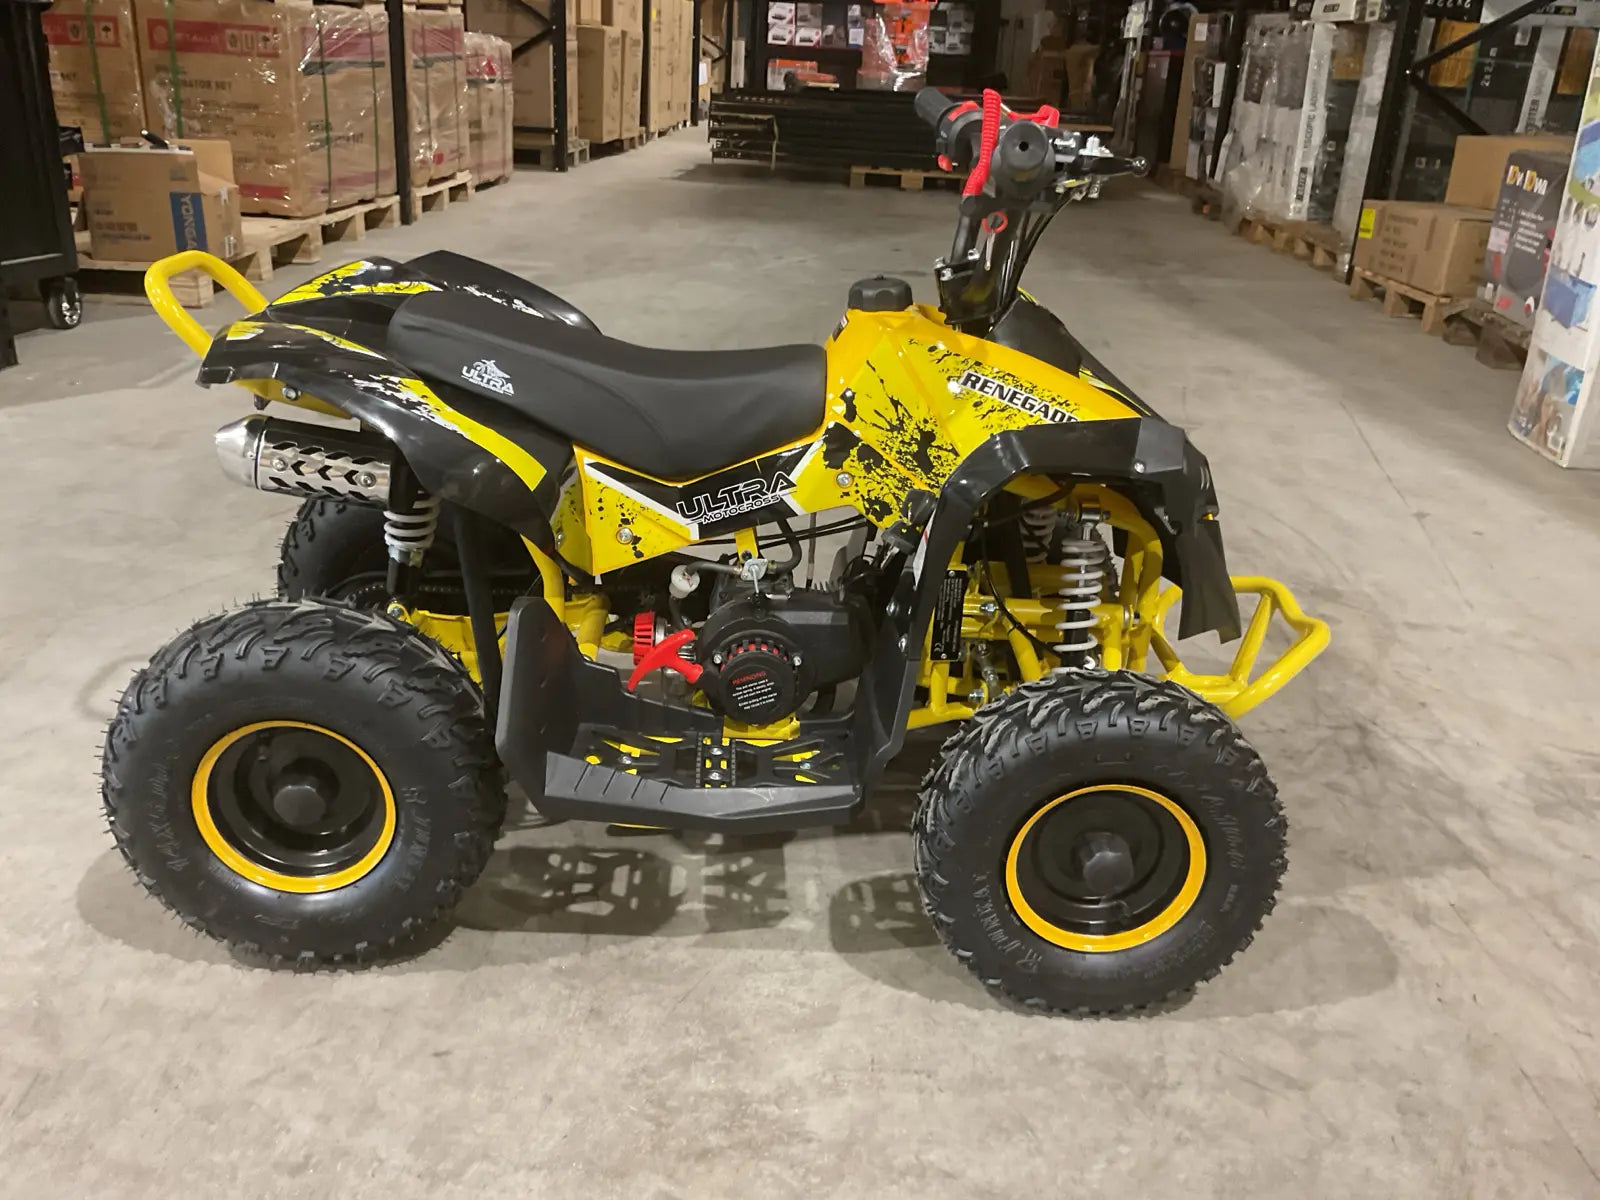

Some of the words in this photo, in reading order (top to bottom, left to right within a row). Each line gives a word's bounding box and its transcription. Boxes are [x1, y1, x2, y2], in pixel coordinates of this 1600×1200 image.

[462, 366, 515, 395] ULTRA
[675, 470, 797, 521] ULTRA
[701, 494, 781, 525] MOTOCROSS
